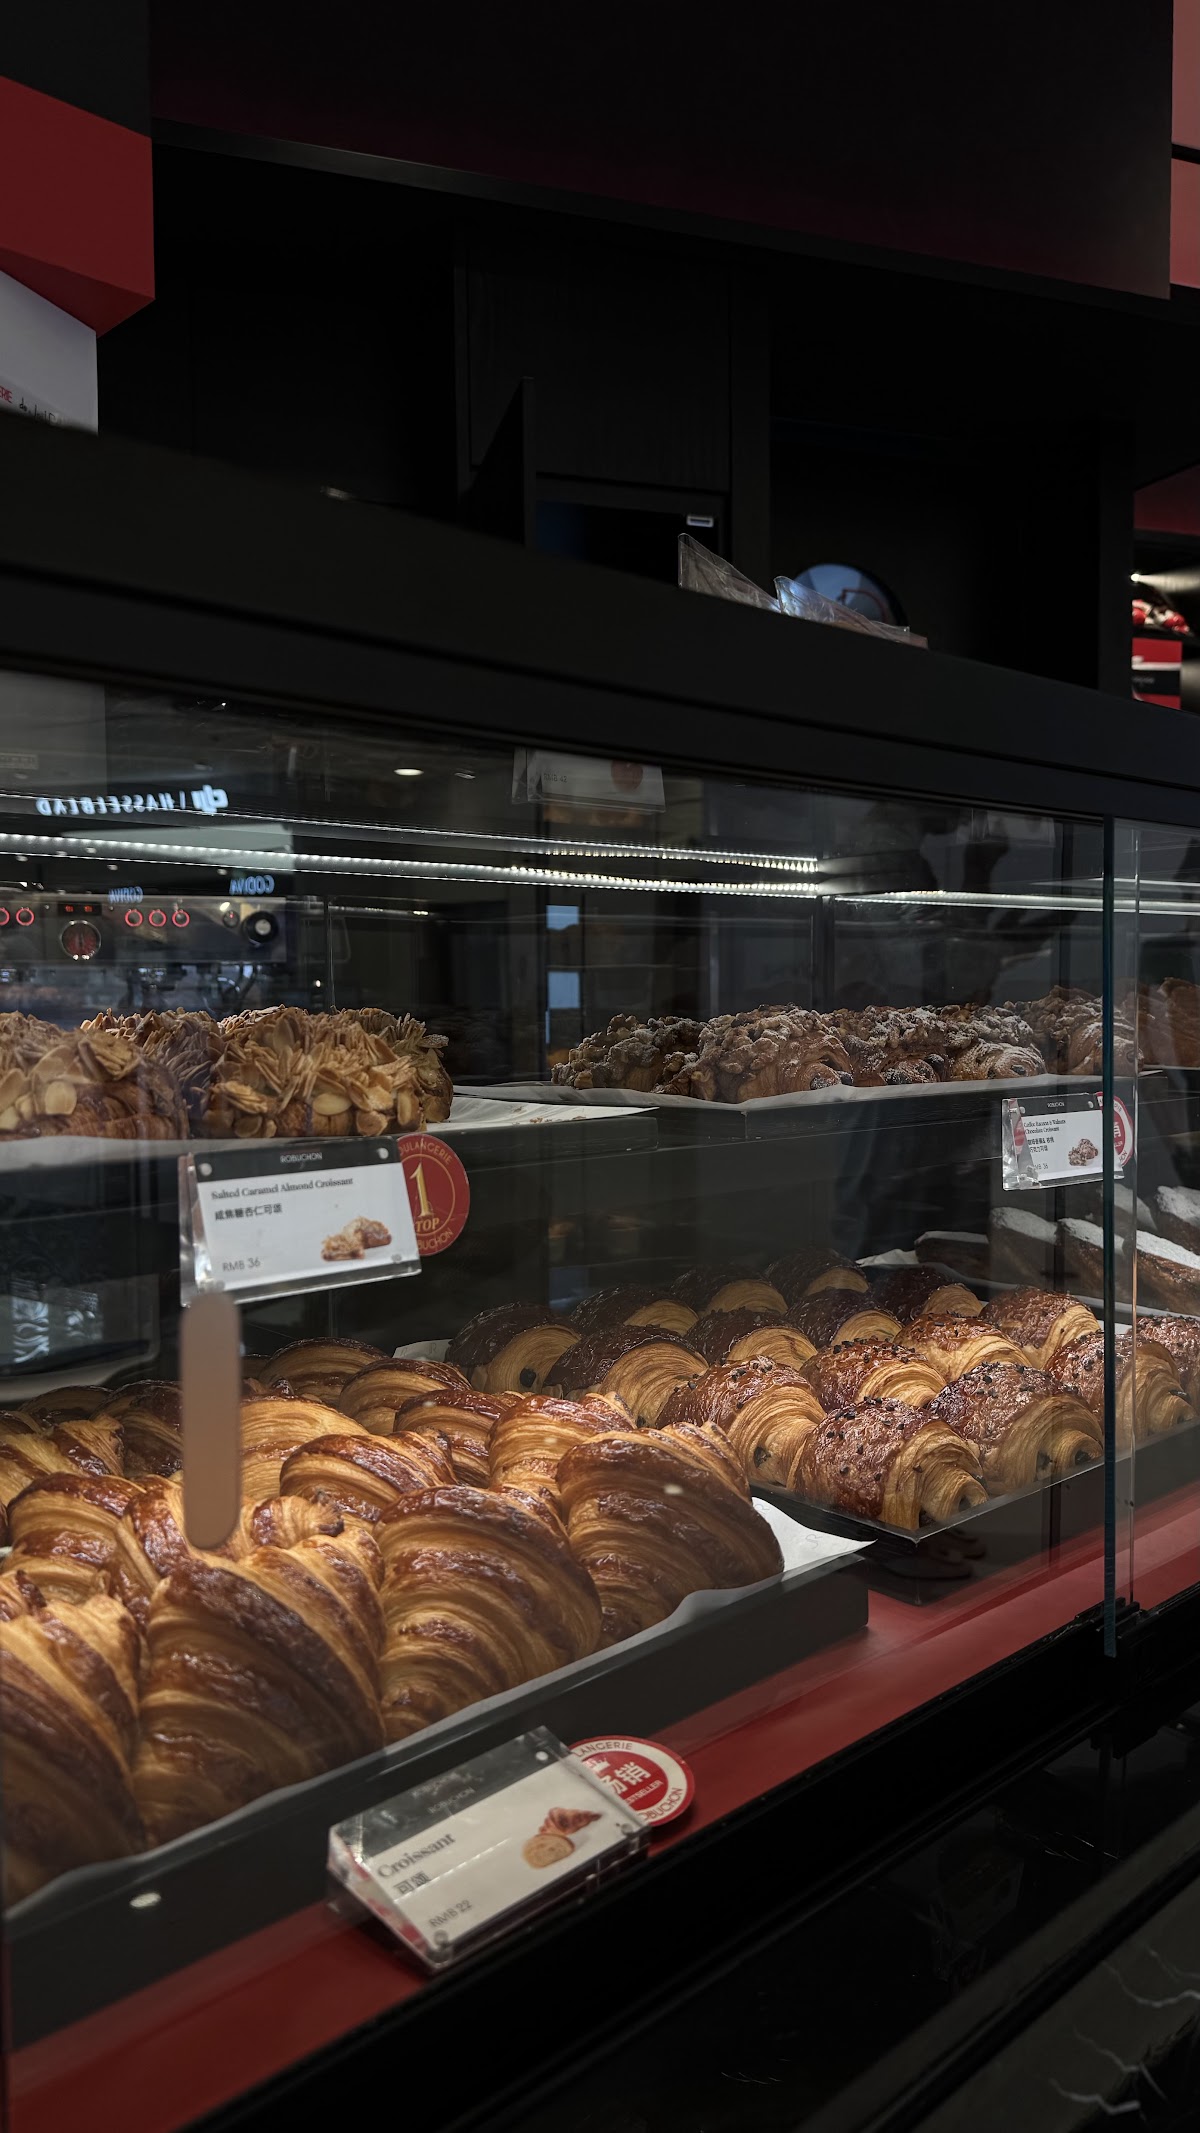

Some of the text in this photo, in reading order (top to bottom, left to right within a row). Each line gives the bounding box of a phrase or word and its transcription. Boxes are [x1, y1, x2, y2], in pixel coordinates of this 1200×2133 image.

[280, 1152, 323, 1163] ROBUCHON
[211, 1178, 354, 1200] Salted Caramel Almond Croissant
[415, 1217, 440, 1233] TOP
[418, 1227, 454, 1250] BUCHON
[222, 1256, 262, 1272] RMB 36
[575, 1741, 633, 1757] LANGERIE
[637, 1787, 684, 1820] OBUCHON
[377, 1833, 457, 1878] Croissant
[393, 1870, 432, 1895] 可颂
[428, 1899, 473, 1928] RMB 22
